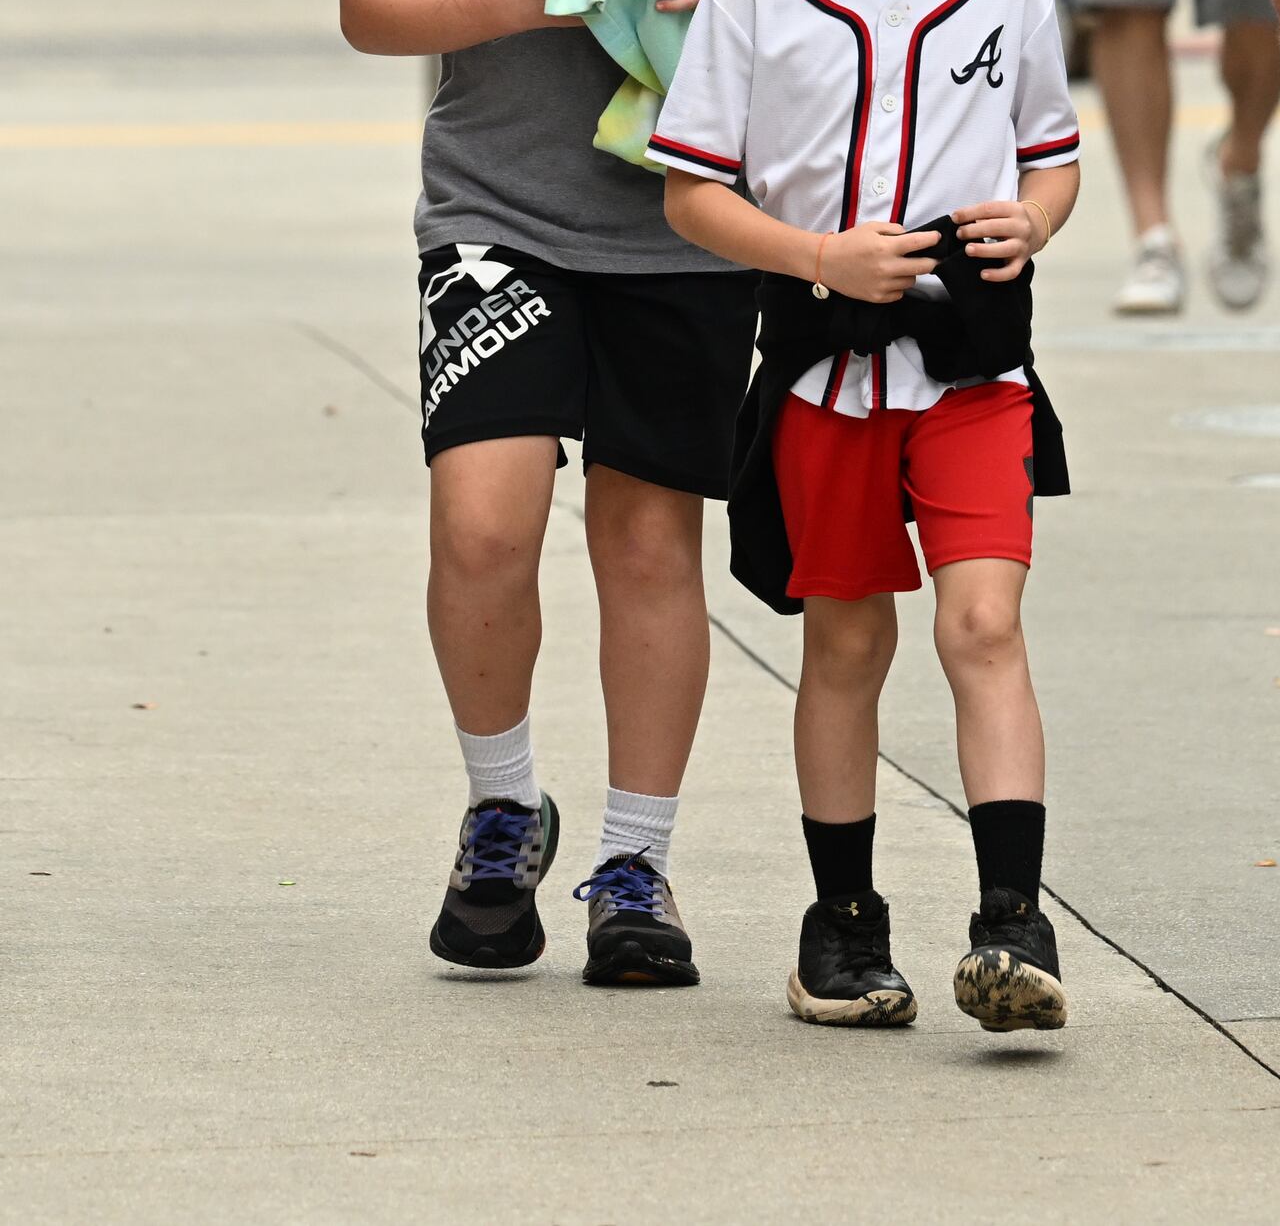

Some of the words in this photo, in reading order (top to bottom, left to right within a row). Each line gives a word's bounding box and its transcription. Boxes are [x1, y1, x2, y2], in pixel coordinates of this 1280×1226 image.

[950, 24, 1005, 89] A
[424, 296, 552, 429] ARMOUR
[425, 279, 537, 379] UNDER
